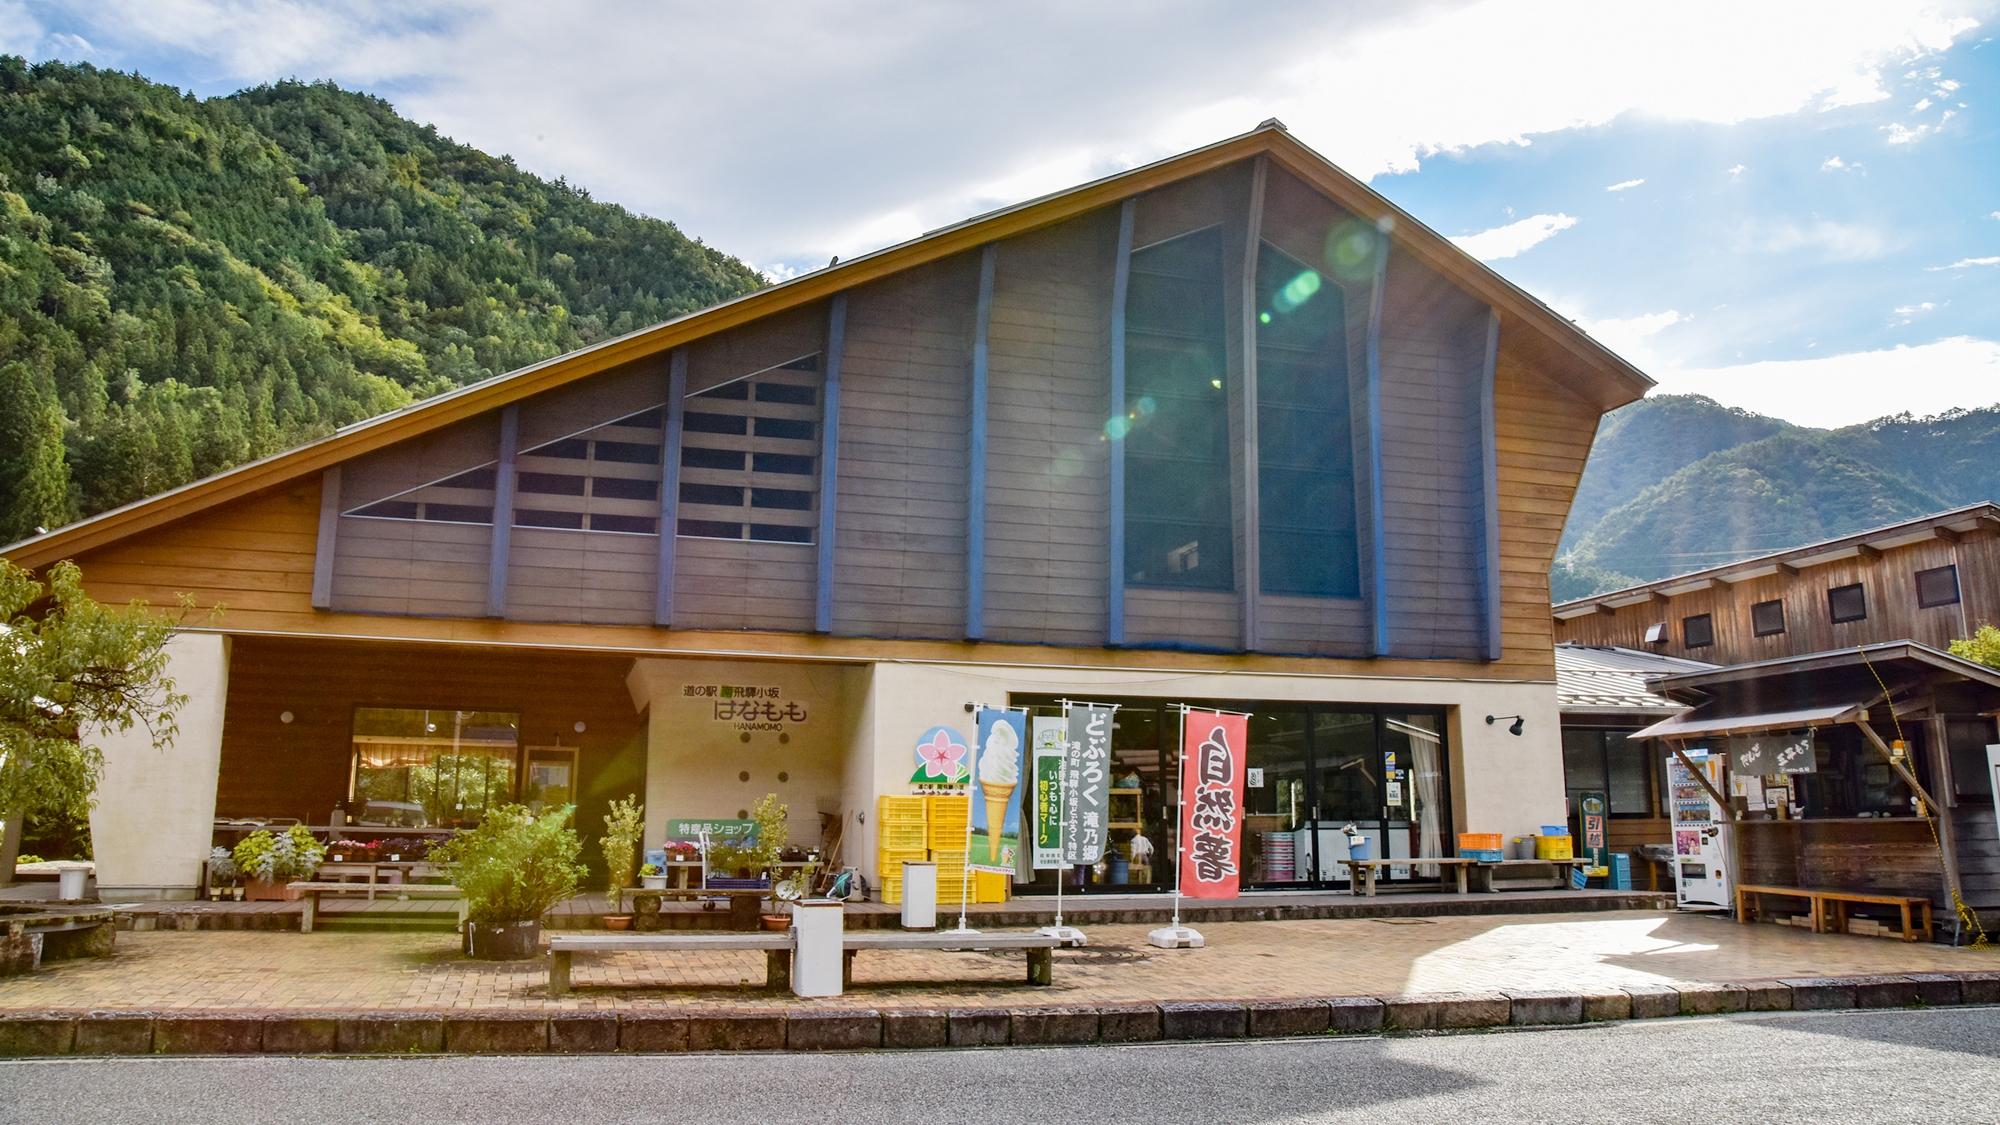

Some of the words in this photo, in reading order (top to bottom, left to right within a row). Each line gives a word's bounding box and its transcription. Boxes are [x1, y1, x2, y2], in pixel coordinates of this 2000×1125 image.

[683, 685, 718, 697] 道の駅
[714, 700, 807, 722] はなもも
[734, 722, 783, 731] HANAMOMO
[1082, 713, 1107, 806] どぶろく
[1039, 780, 1050, 844] 初心者マーク
[1049, 770, 1058, 826] いつも心に
[679, 823, 754, 834] 特産品ショップ
[1082, 810, 1099, 860] 滝乃郷
